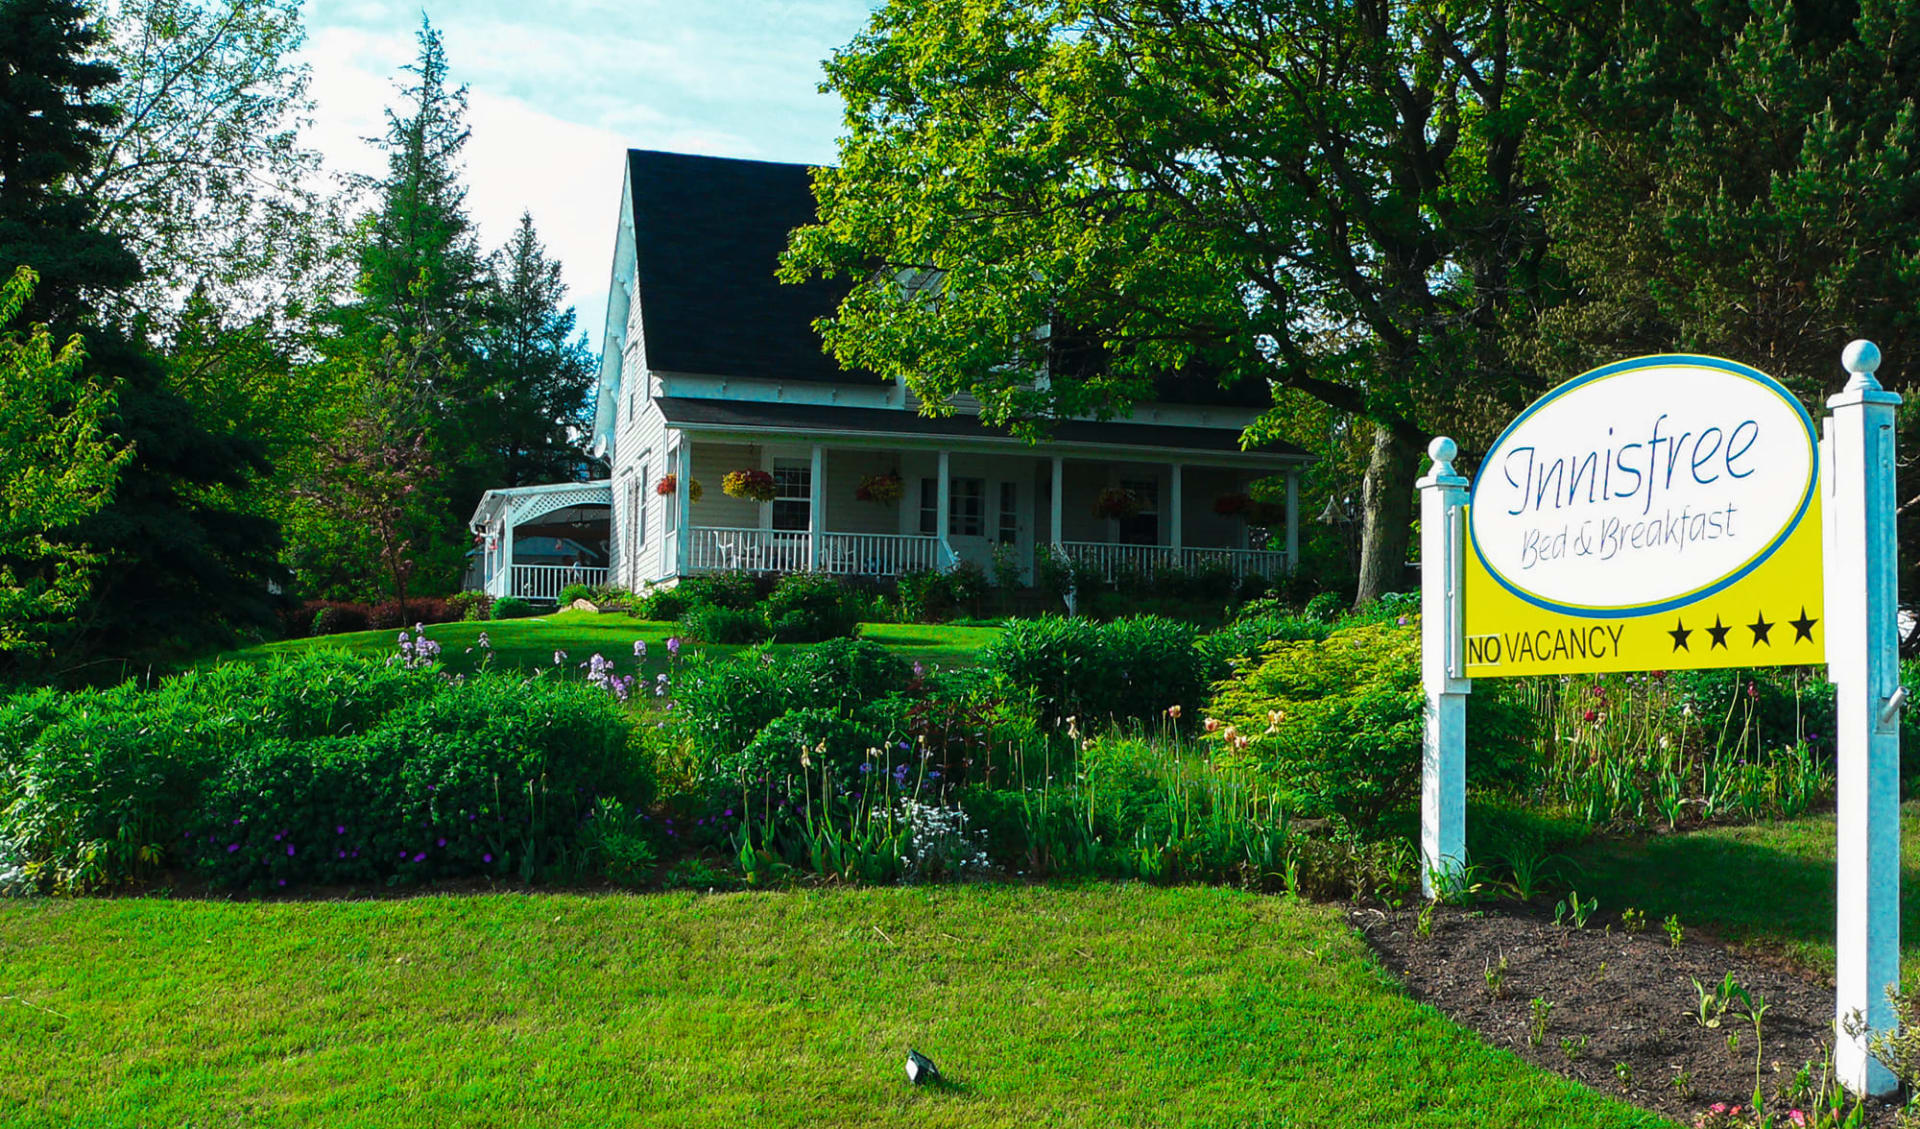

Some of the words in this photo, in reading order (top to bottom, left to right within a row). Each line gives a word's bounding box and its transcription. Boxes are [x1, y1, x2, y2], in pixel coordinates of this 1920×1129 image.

[1504, 414, 1759, 516] Innisfree
[1521, 527, 1568, 570] Bed
[1573, 520, 1594, 556] &
[1599, 502, 1738, 561] Breakfast
[1468, 636, 1500, 664] NO
[1505, 624, 1624, 663] VACANCY
